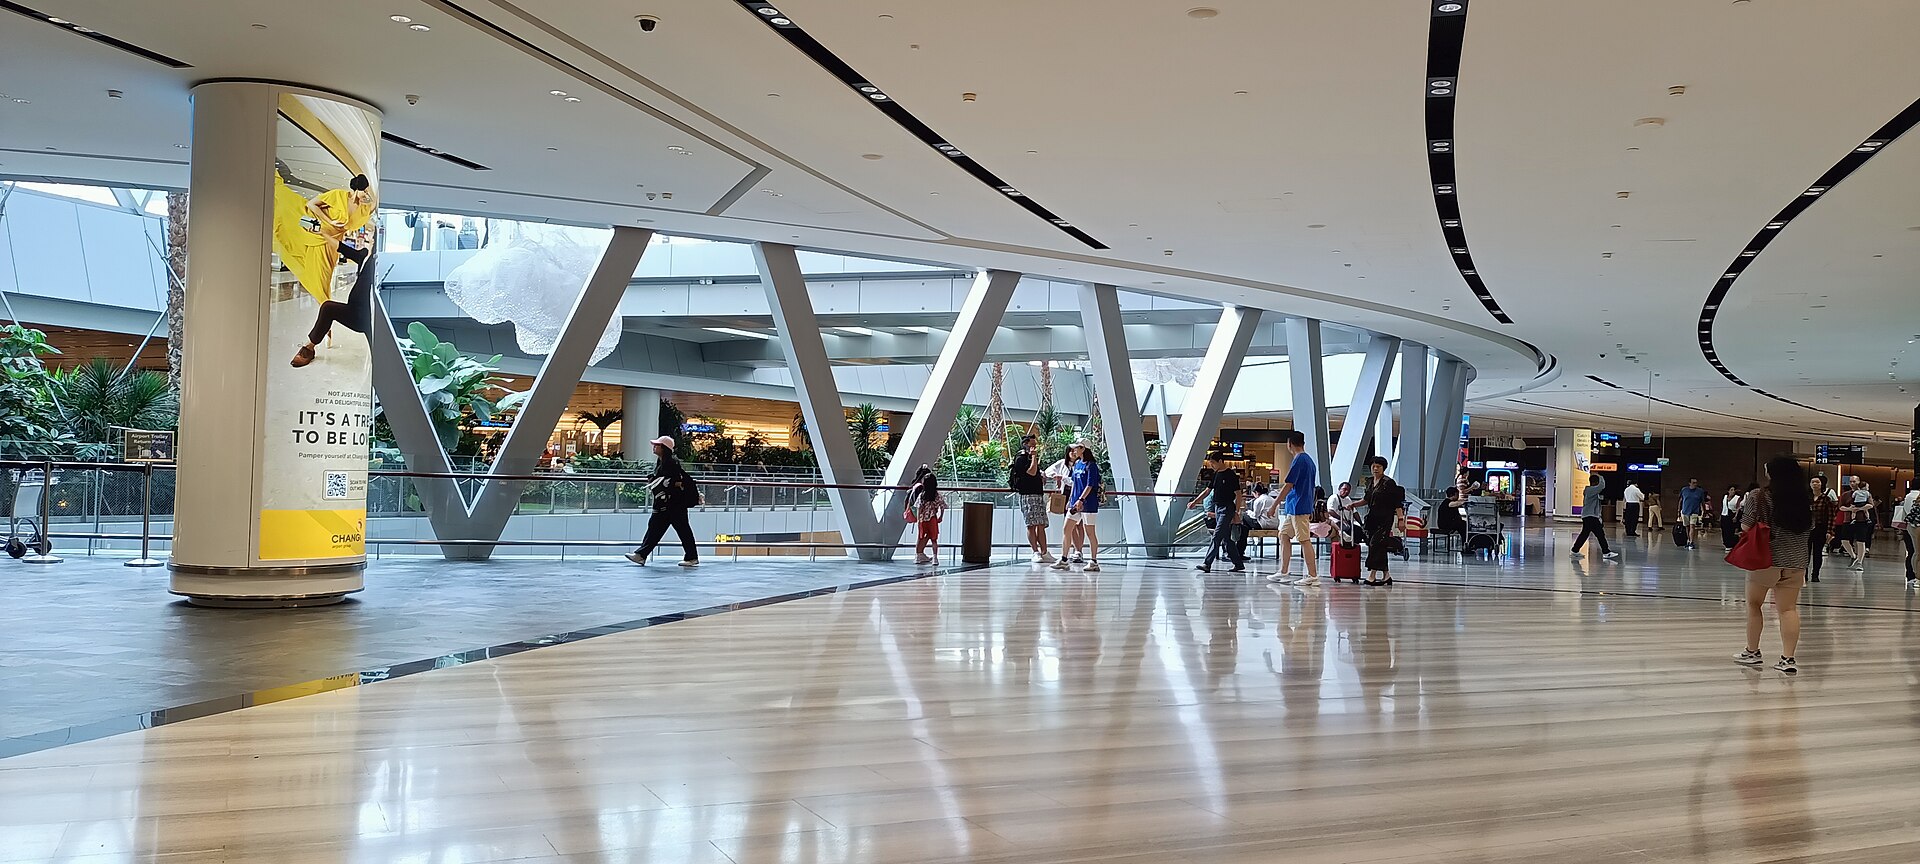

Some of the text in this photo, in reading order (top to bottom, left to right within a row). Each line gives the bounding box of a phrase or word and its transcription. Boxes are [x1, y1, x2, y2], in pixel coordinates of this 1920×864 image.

[299, 411, 335, 425] IT'S
[341, 413, 350, 427] A
[292, 430, 319, 444] TO
[327, 431, 347, 445] BE
[566, 430, 599, 443] 17 17
